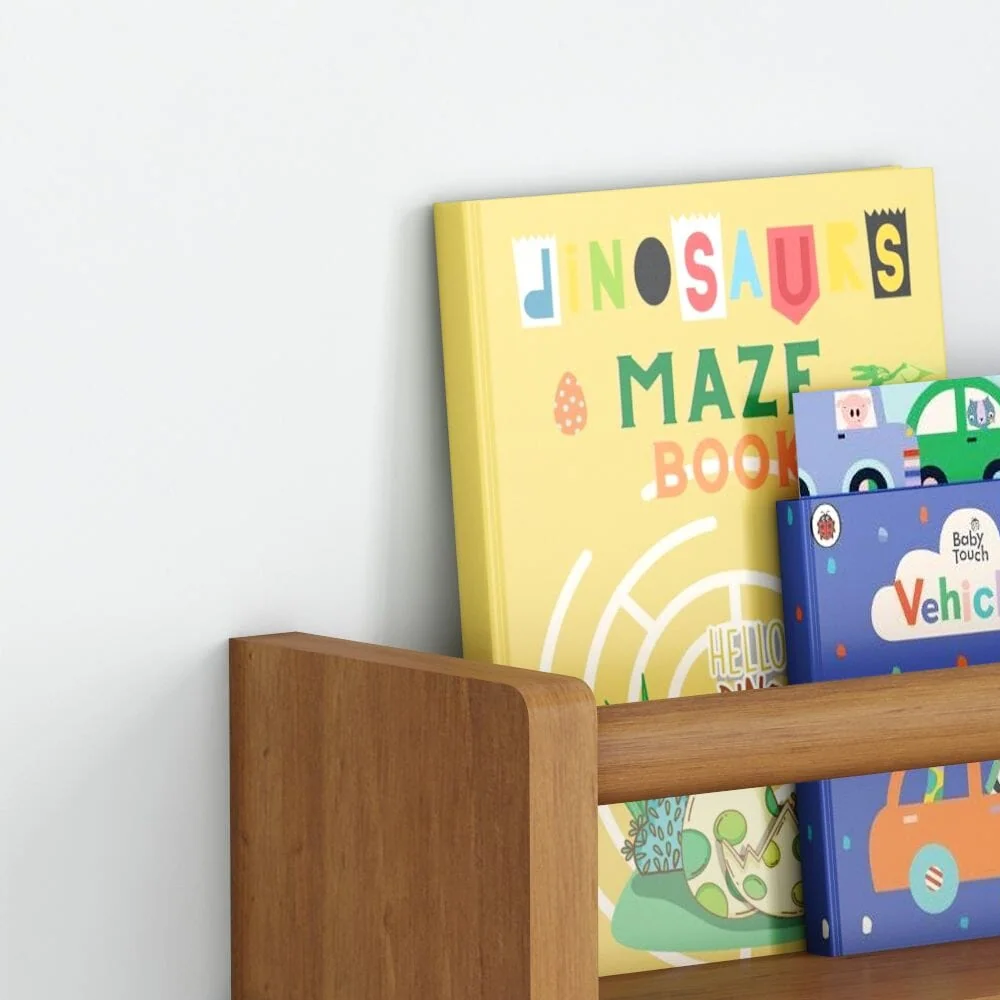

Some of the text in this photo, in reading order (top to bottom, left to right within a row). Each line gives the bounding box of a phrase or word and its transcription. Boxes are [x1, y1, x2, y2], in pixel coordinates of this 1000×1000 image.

[616, 338, 821, 428] MAZE
[952, 530, 984, 549] Baby
[952, 544, 989, 564] Touch
[708, 622, 785, 676] HELLO
